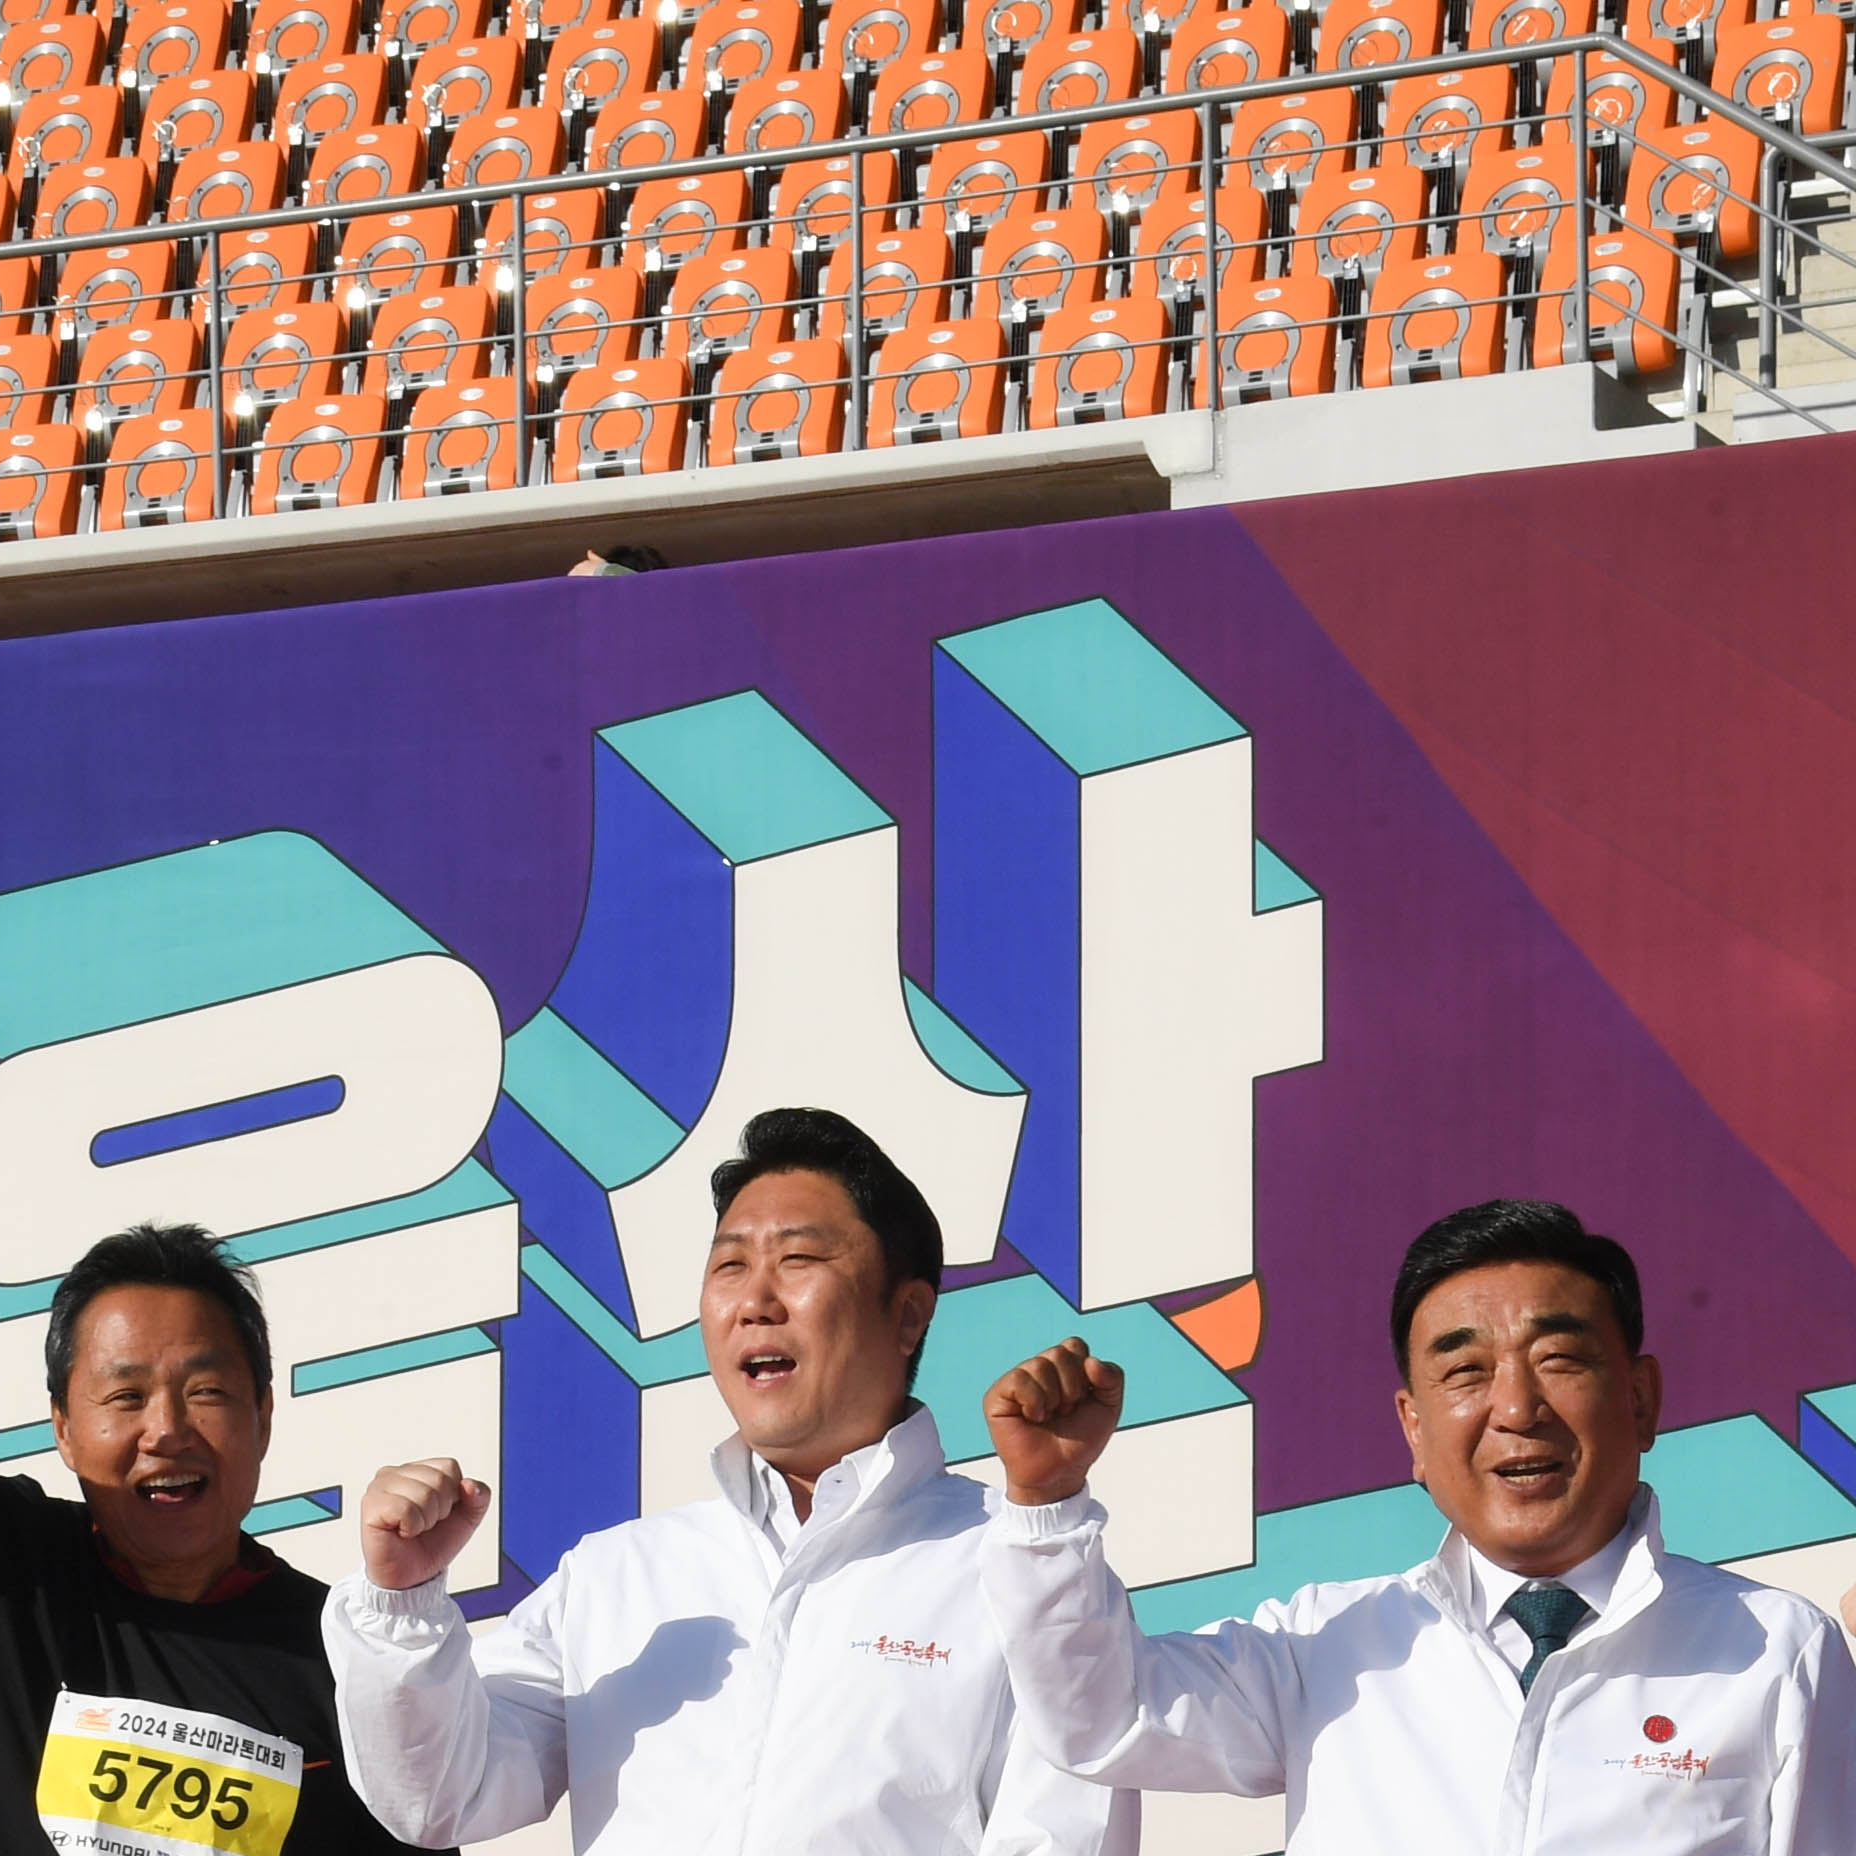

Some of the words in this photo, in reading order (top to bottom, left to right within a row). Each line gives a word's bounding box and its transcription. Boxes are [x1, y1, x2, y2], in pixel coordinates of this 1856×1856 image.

[873, 1635, 951, 1667] 울산공업축제
[118, 1713, 168, 1738] 2024
[172, 1723, 286, 1770] 울산마라톤대회
[88, 1750, 253, 1830] 5795
